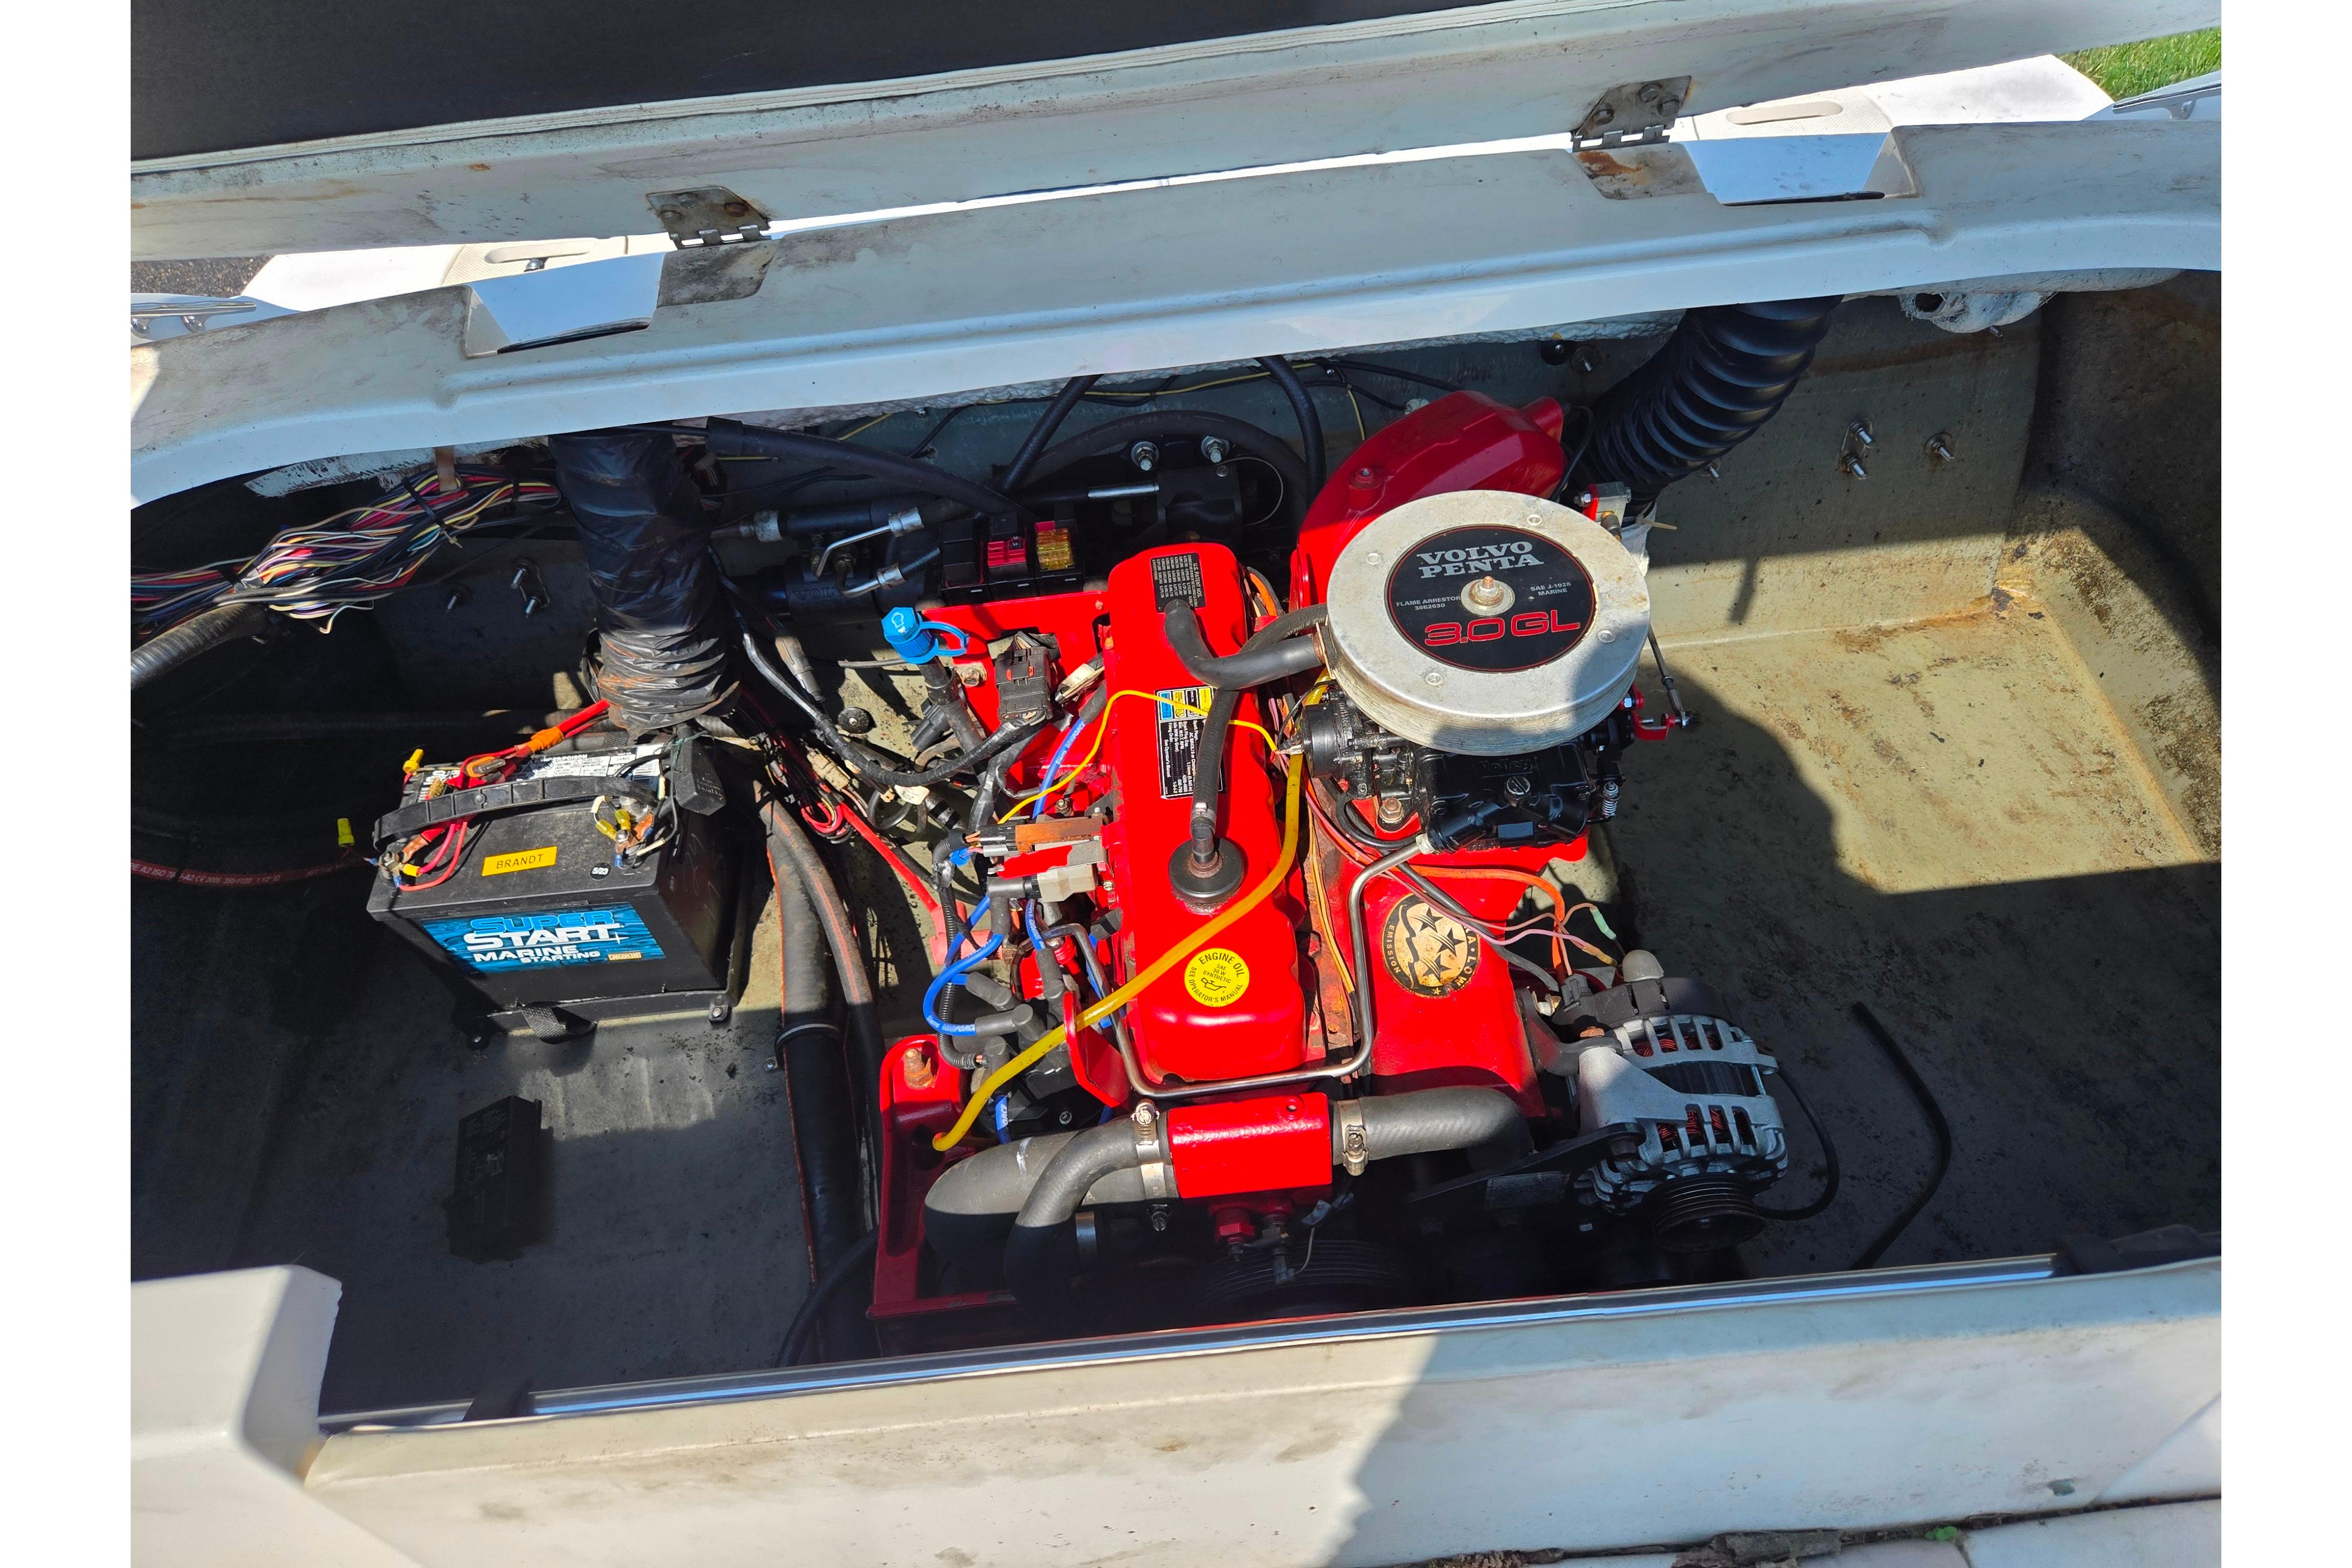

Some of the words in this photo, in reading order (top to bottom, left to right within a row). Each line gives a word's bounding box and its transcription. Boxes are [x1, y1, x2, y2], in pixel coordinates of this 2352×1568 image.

[1416, 541, 1533, 565] VOLVO
[1418, 554, 1544, 579] PENTA
[1423, 595, 1461, 605] ARRESTOR
[1538, 587, 1568, 596] MARINE
[1055, 750, 1067, 766] Sierra
[432, 770, 460, 778] SUP
[496, 854, 544, 870] BRANDT
[470, 909, 615, 933] SUPER
[463, 923, 621, 951] START
[472, 944, 579, 962] MARINE
[520, 950, 601, 964] STARTING
[1386, 924, 1401, 974] EMISSION
[1189, 966, 1197, 978] SEE
[1198, 952, 1236, 964] ENGINE
[1233, 963, 1244, 978] OIL
[1454, 955, 1477, 987] LOW
[1203, 970, 1232, 984] SYNTHETIC
[1189, 979, 1219, 1003] OPERATOR'S
[1220, 984, 1243, 1002] MANUAL
